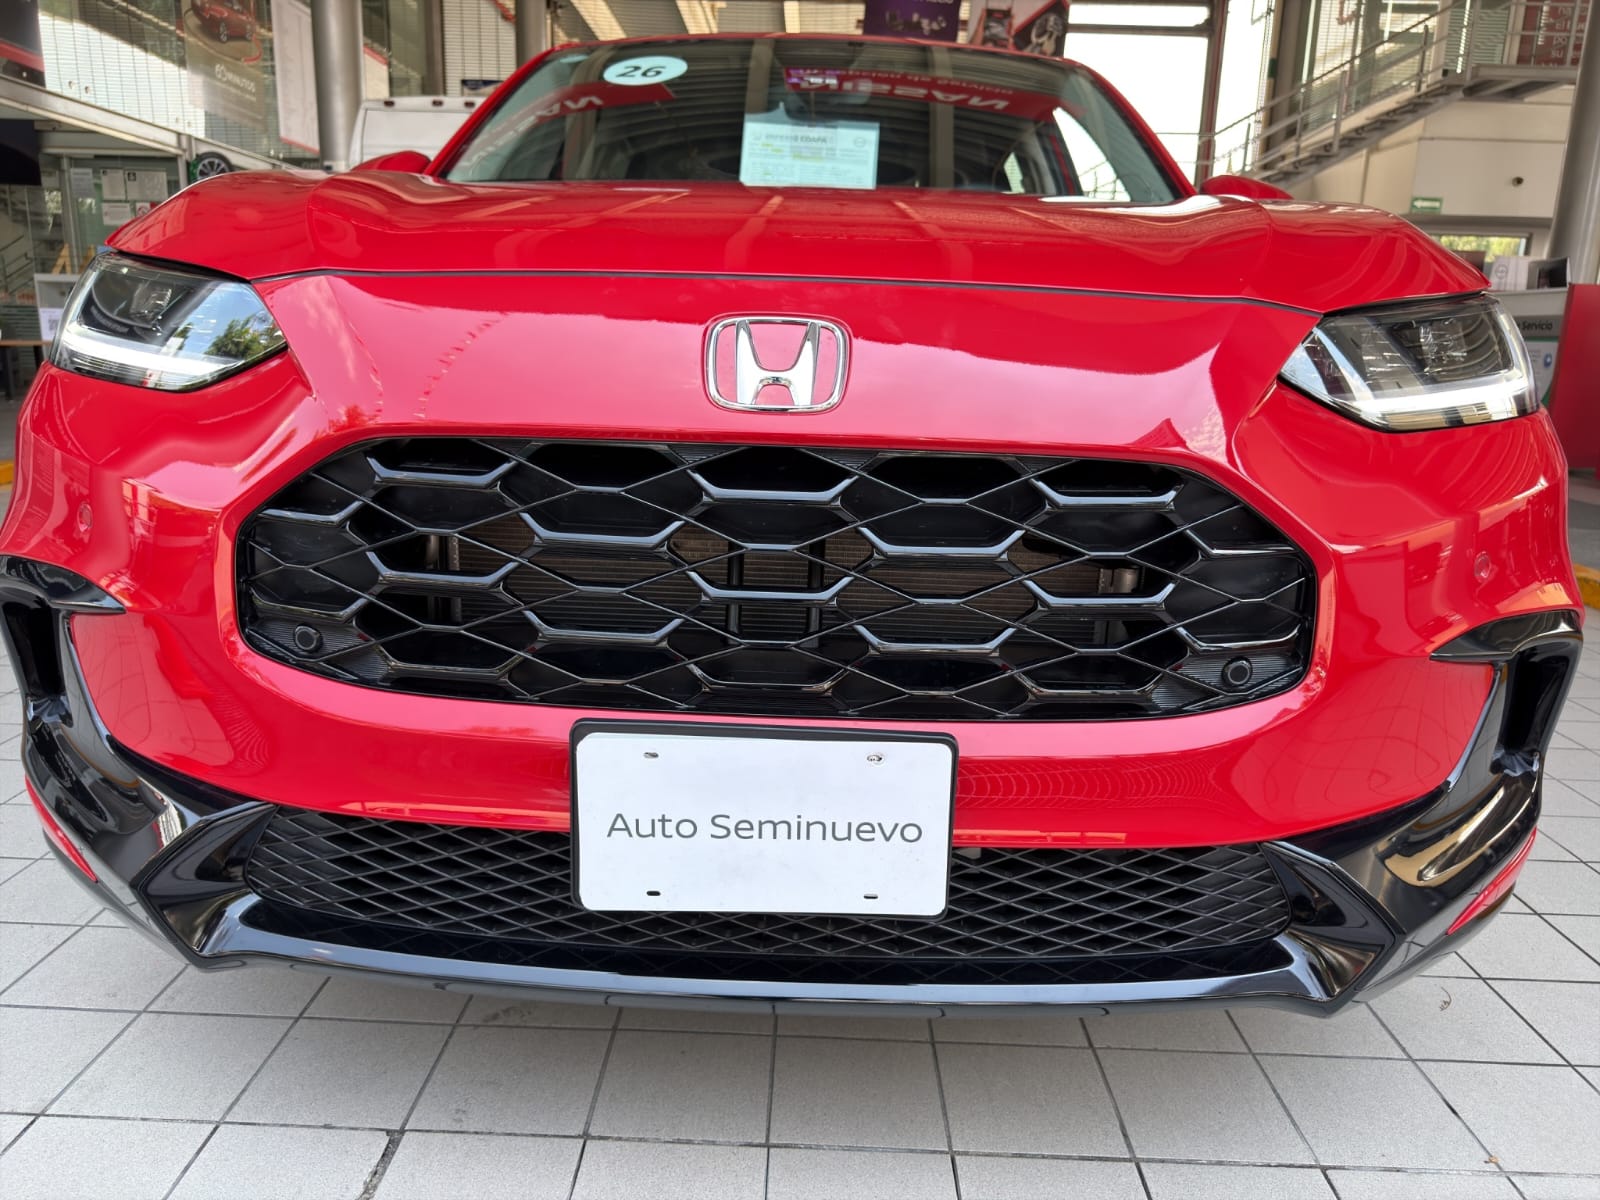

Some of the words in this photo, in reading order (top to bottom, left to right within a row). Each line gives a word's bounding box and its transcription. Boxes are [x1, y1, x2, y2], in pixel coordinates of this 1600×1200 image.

[615, 65, 666, 78] 26
[606, 812, 698, 839] Auto
[709, 814, 923, 844] Seminuevo
